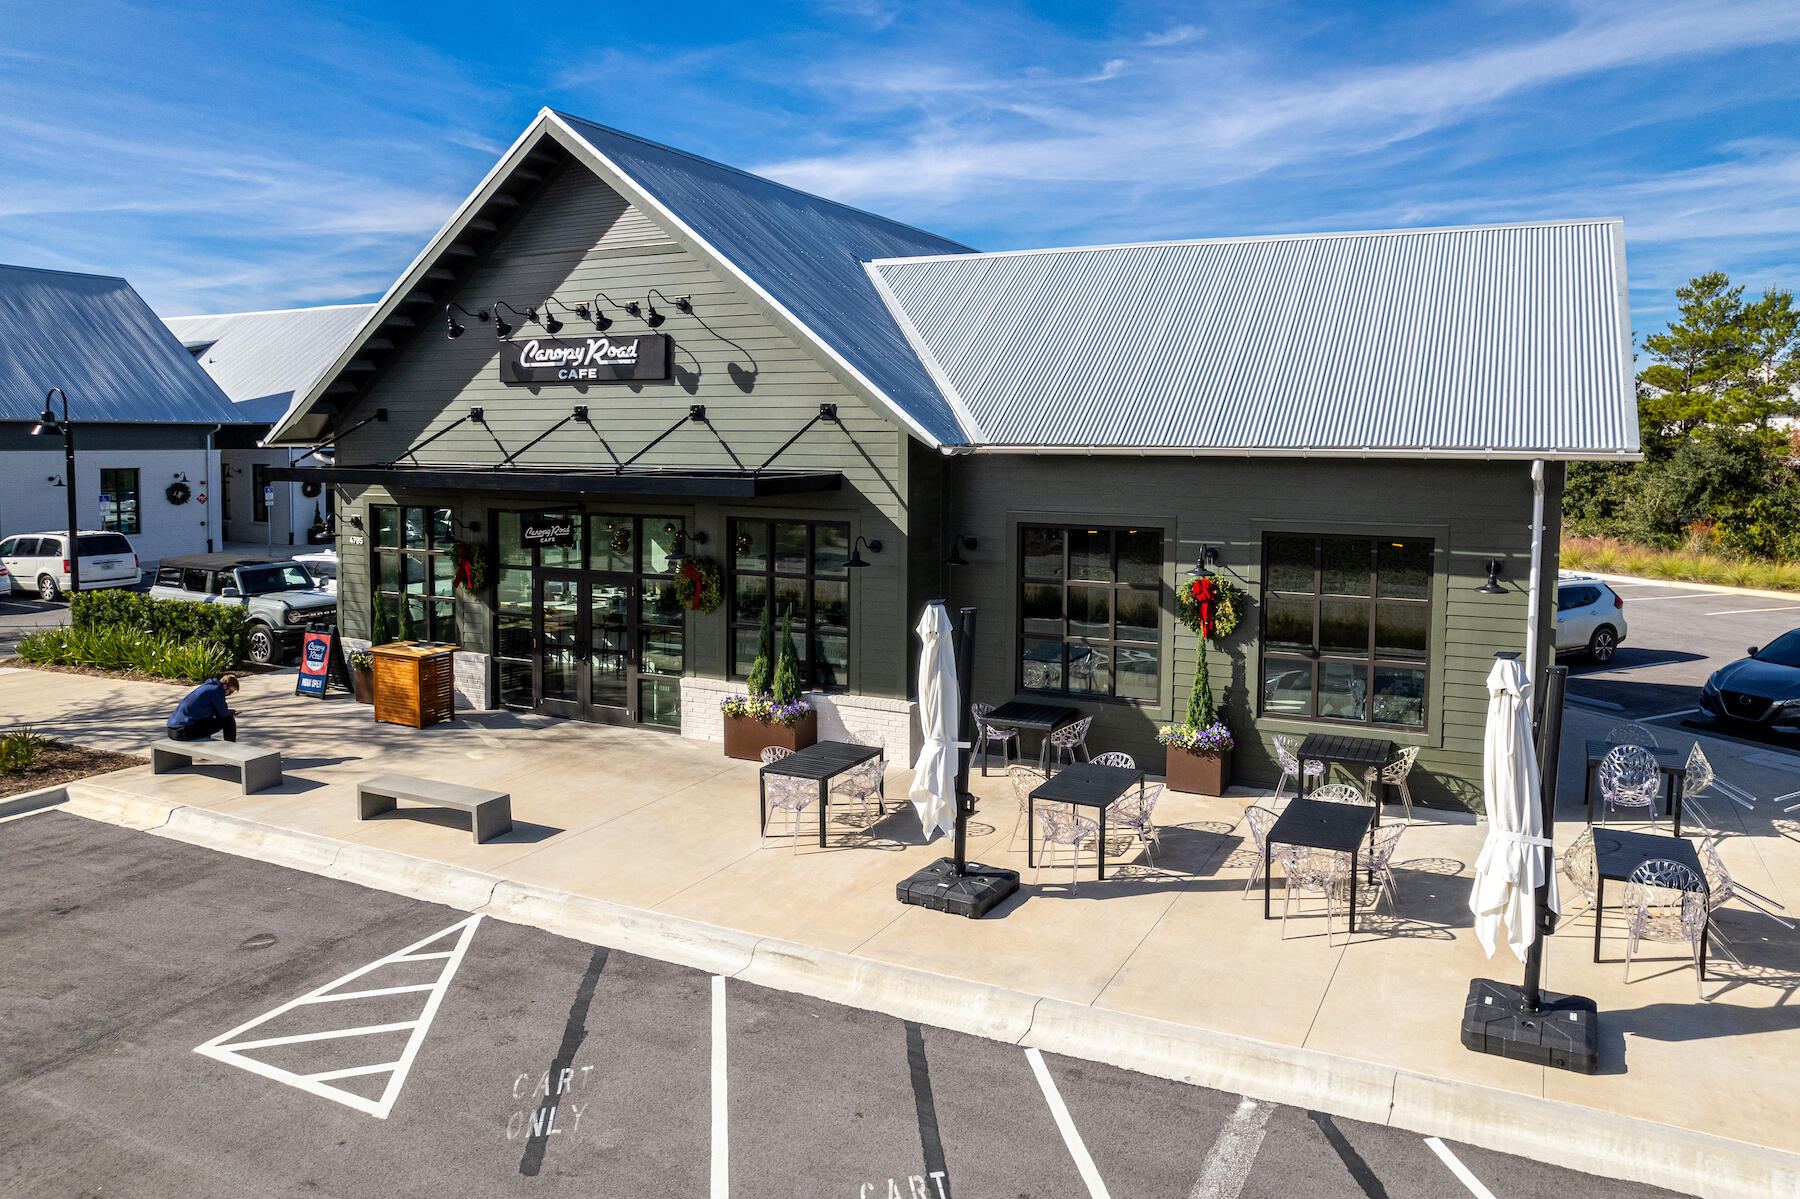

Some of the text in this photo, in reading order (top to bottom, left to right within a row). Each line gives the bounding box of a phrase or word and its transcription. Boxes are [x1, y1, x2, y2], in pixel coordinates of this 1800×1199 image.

[520, 338, 639, 367] Canopy Road
[558, 368, 598, 380] CAFE
[525, 524, 571, 539] Canopy Road
[512, 1064, 594, 1099] CART
[506, 1103, 589, 1140] ONLY
[859, 1170, 947, 1199] CART
